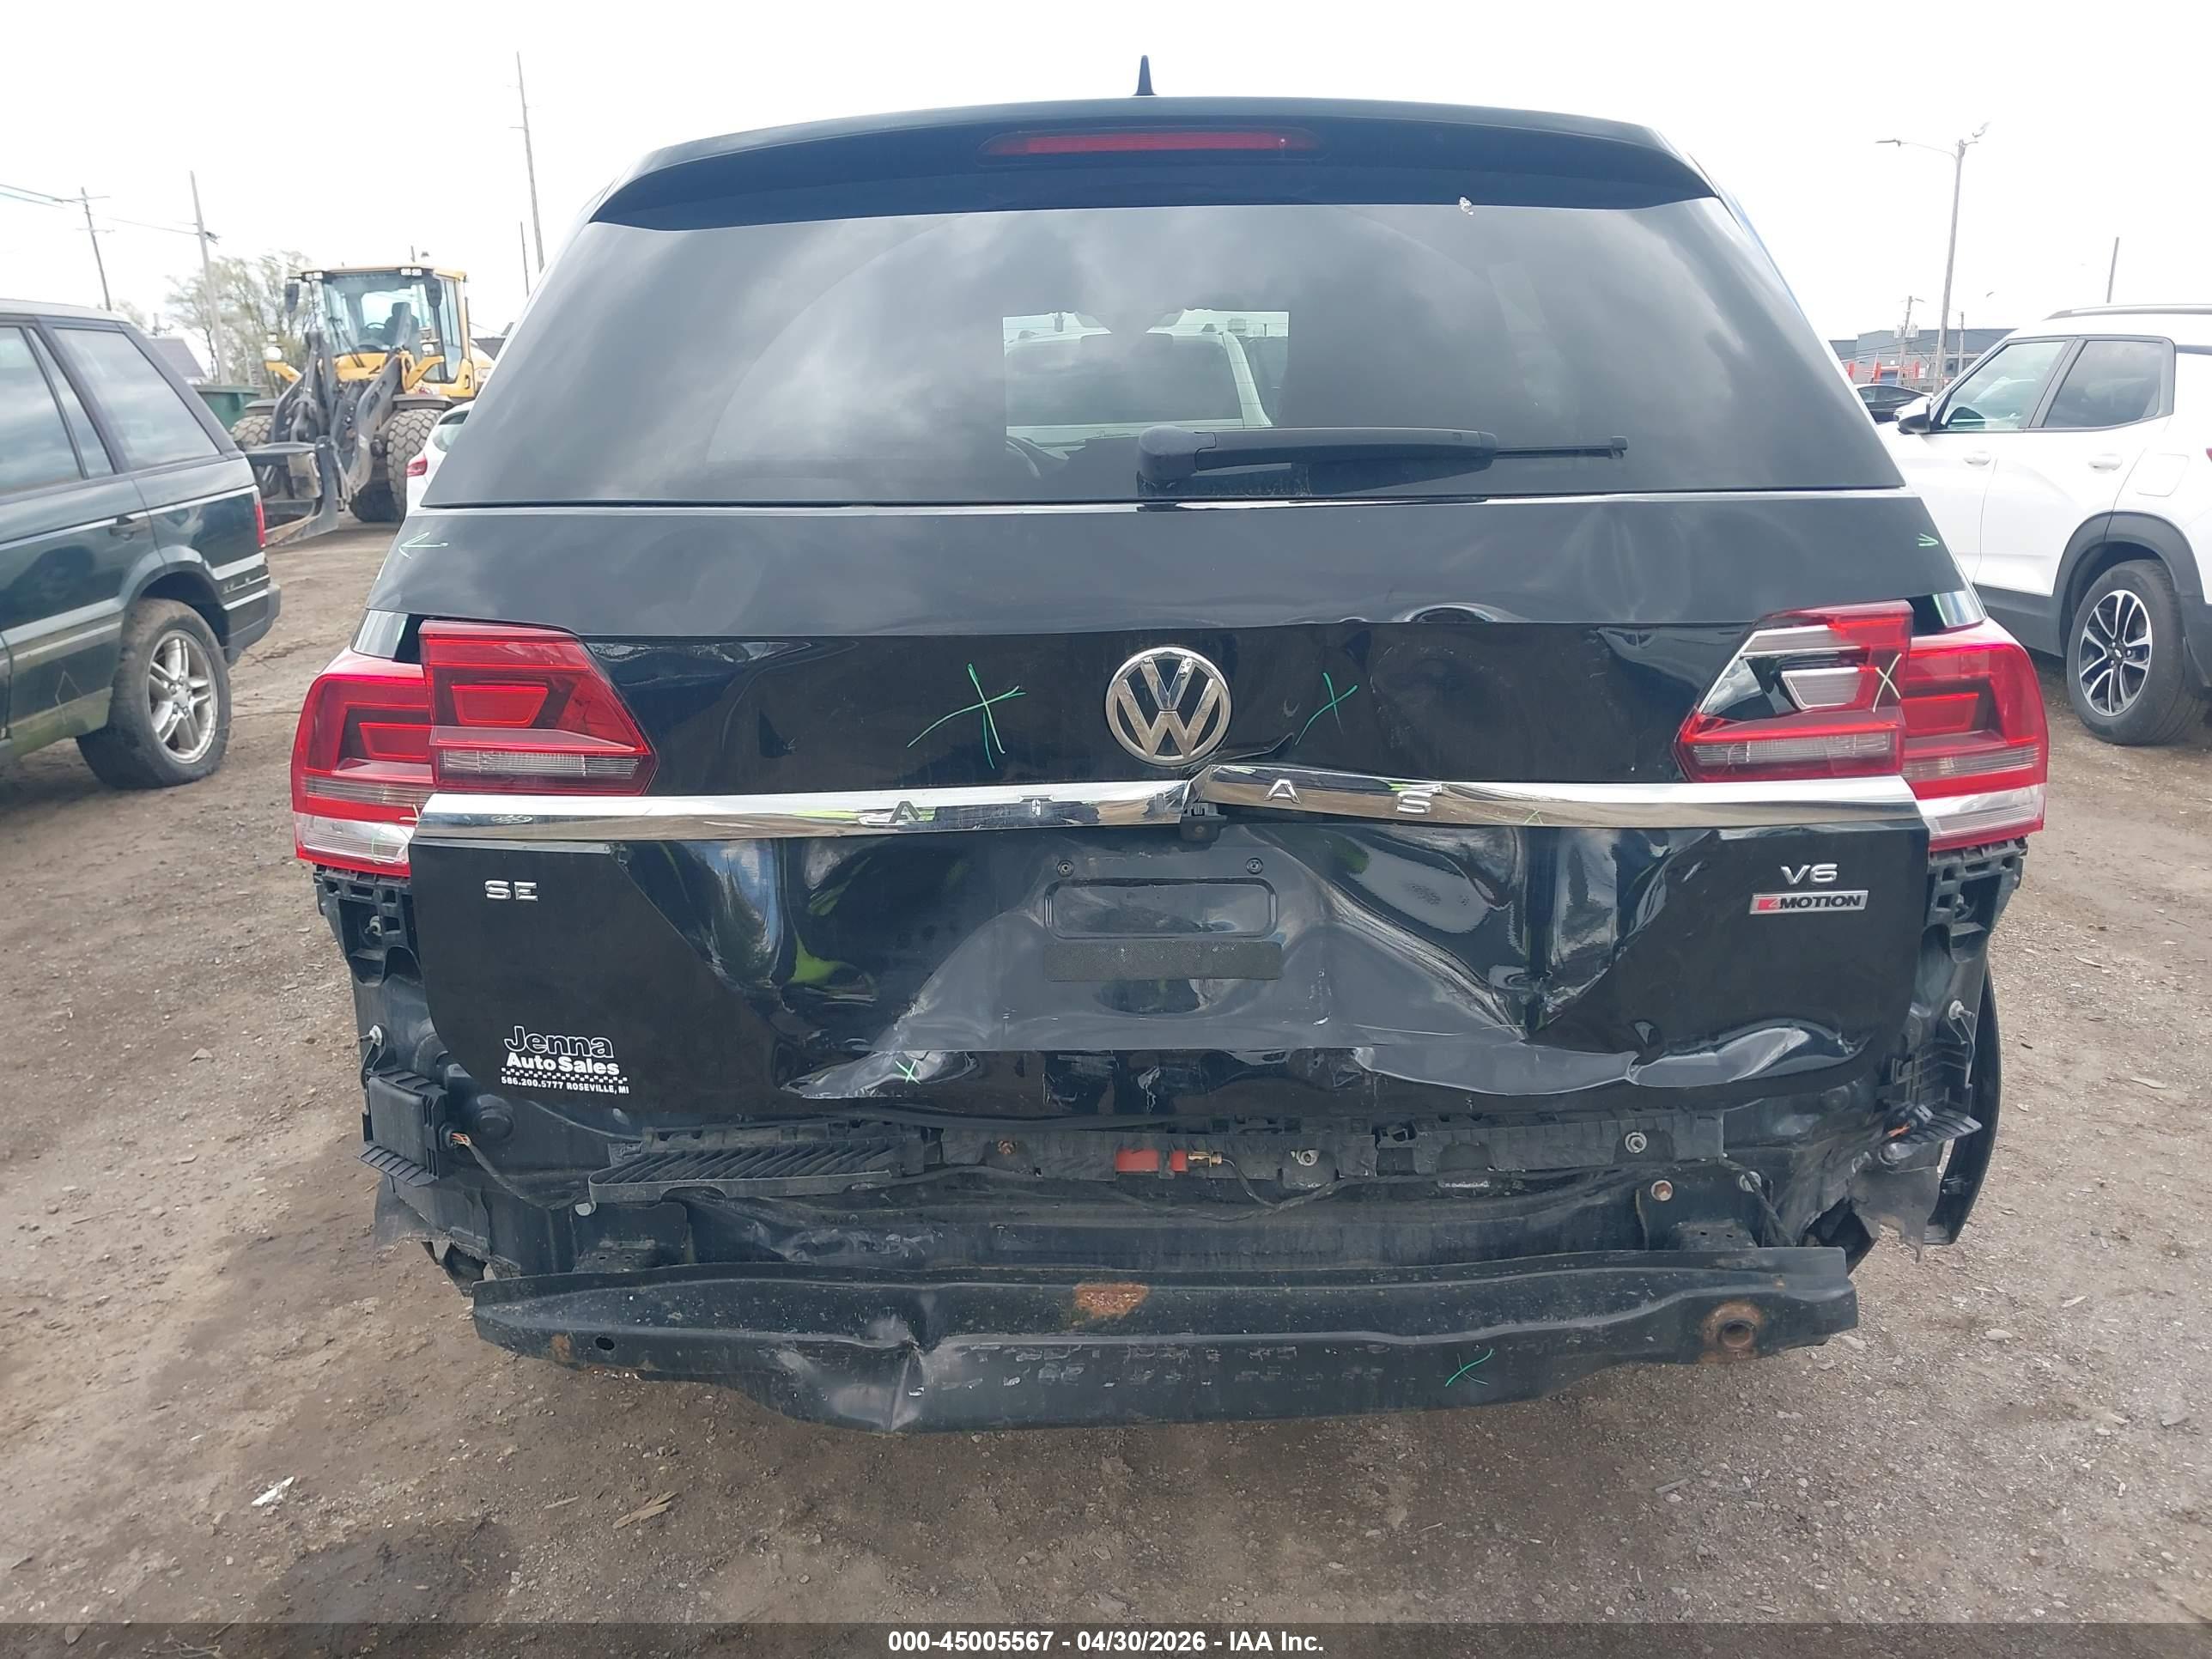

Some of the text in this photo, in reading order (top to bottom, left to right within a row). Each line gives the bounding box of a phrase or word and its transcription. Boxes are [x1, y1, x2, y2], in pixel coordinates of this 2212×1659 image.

[1780, 862, 1838, 885] V6
[483, 879, 539, 902] SE
[503, 1025, 615, 1059] Jenna
[506, 1052, 620, 1075] Auto Sales
[501, 1076, 630, 1095] 586.200.5777 ROSEVILLE, MI
